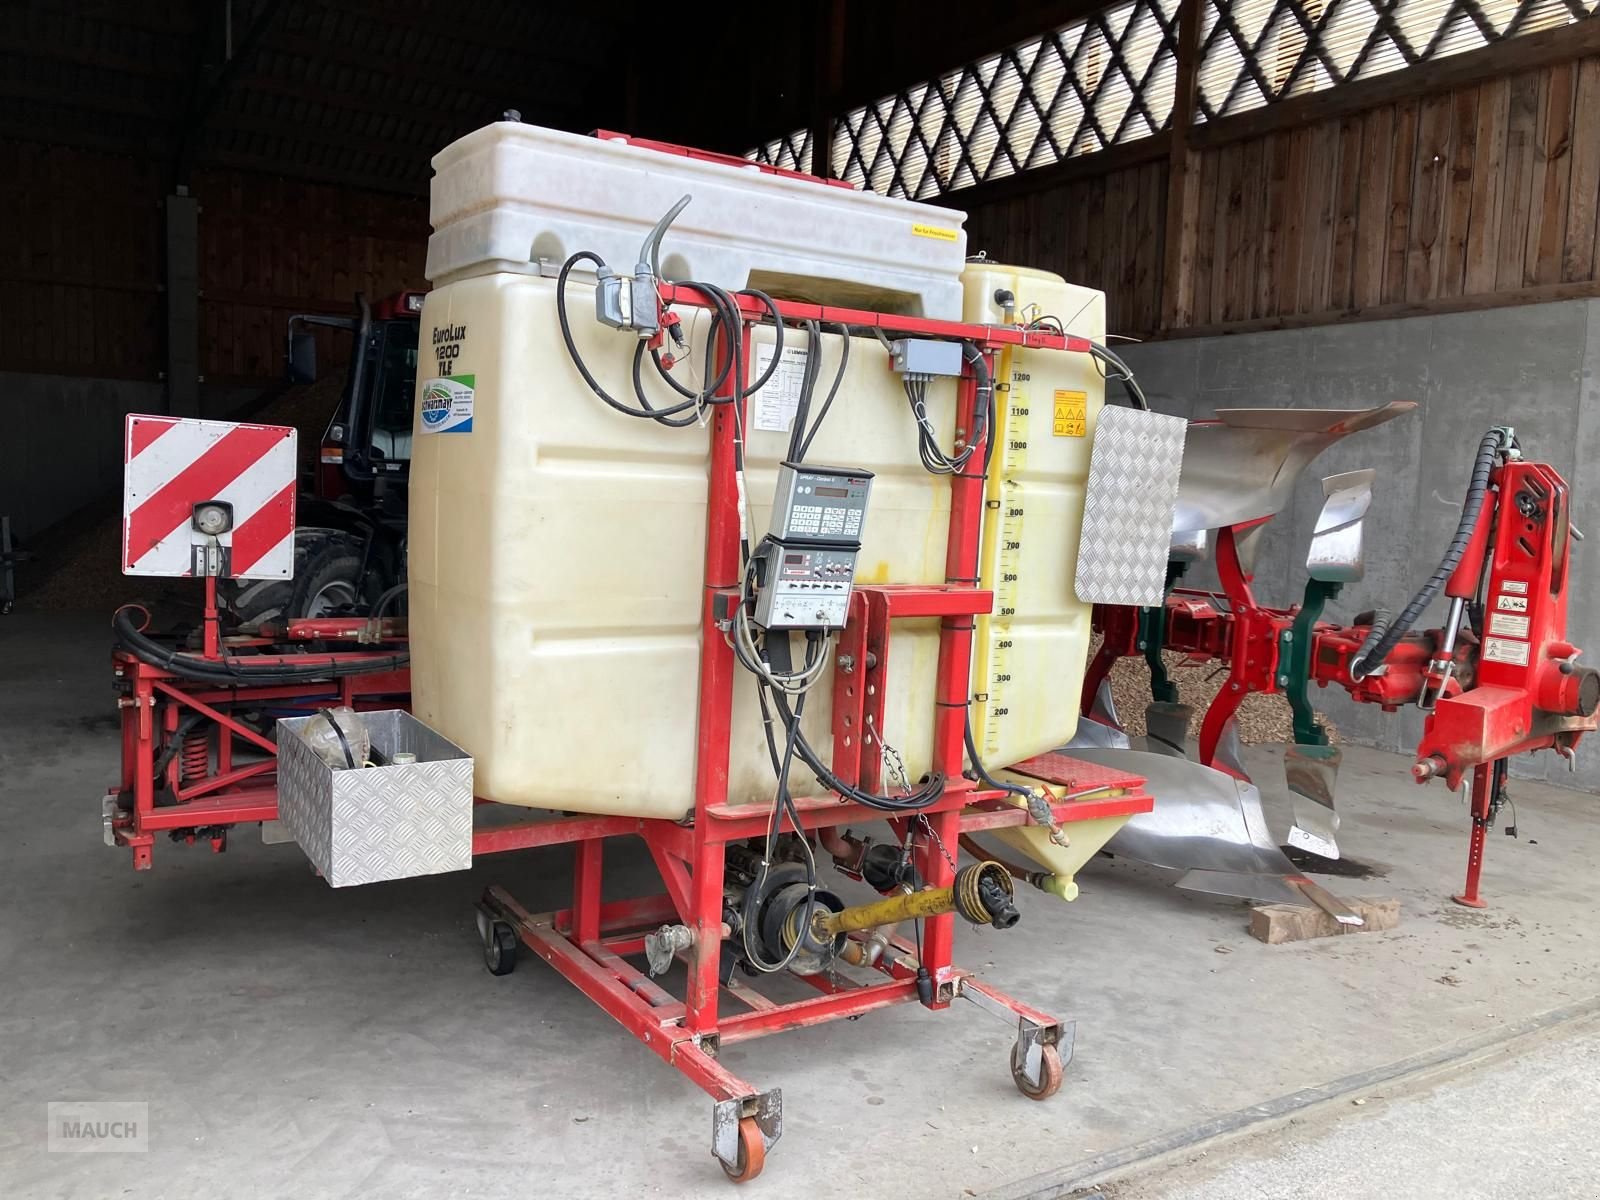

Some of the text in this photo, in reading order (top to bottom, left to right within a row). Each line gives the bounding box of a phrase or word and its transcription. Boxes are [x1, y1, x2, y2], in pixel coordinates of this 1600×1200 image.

[432, 324, 466, 344] EuroLux
[435, 344, 460, 360] 1200
[438, 360, 452, 376] TLE
[1013, 372, 1030, 381] 1200
[1010, 442, 1027, 450] 1000
[998, 640, 1012, 648] 400
